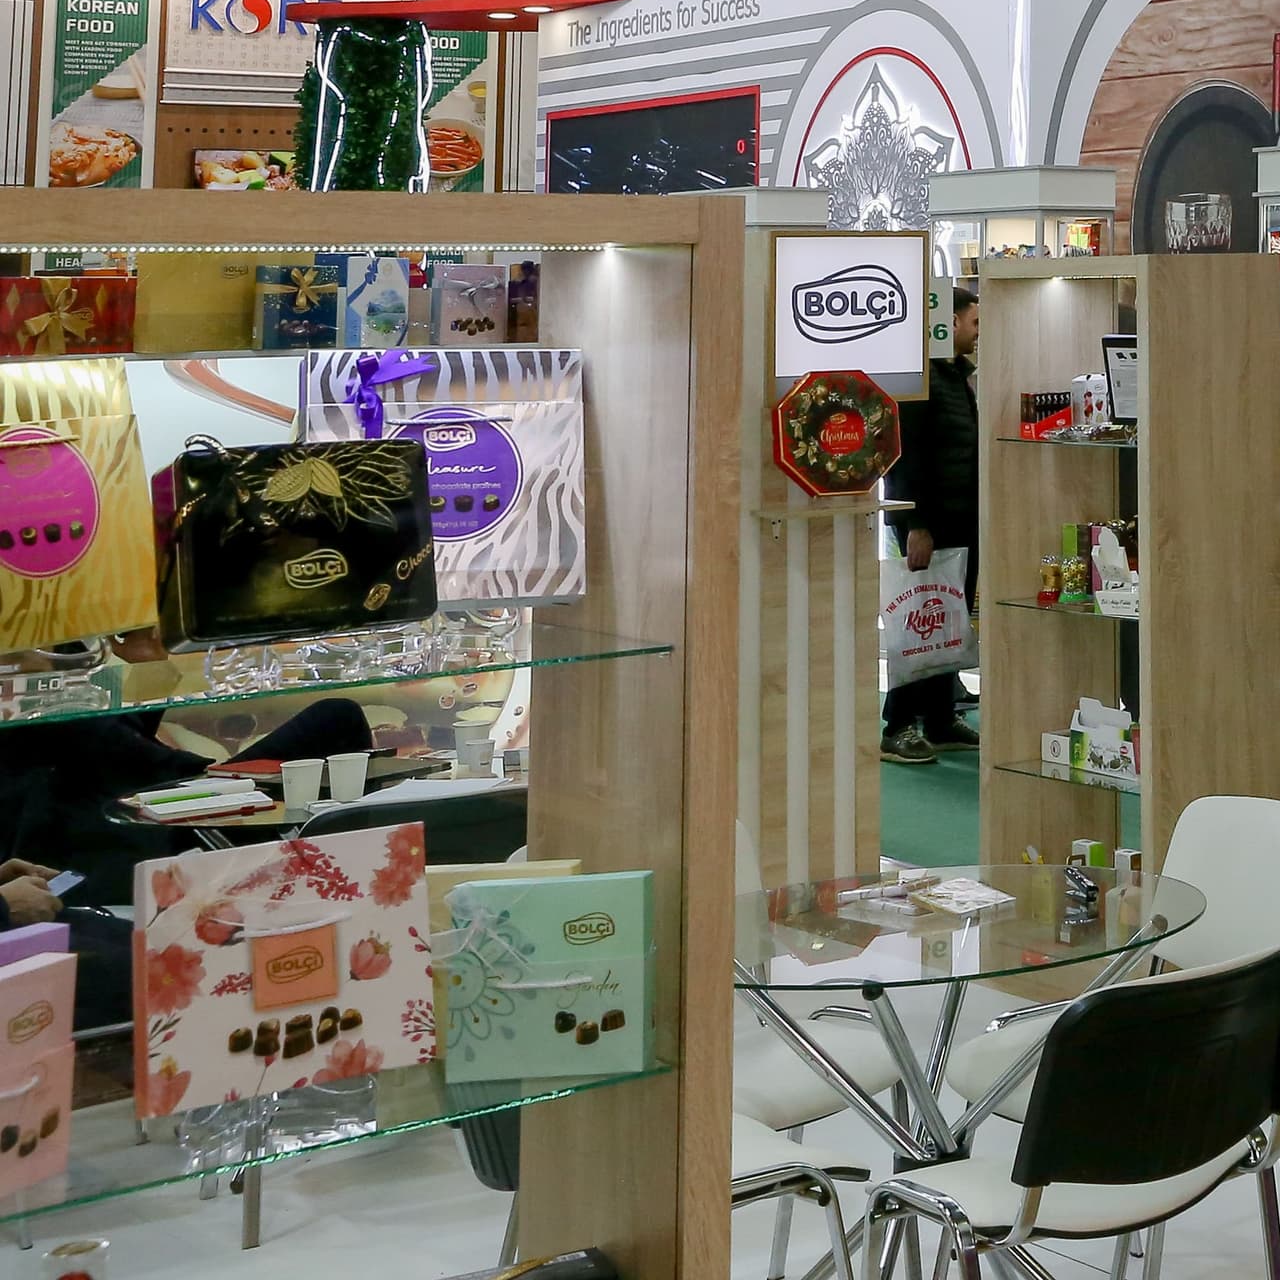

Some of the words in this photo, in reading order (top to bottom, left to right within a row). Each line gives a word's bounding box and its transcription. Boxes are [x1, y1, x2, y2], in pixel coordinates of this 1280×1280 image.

[66, 18, 115, 33] FOOD
[567, 21, 592, 47] The
[596, 6, 672, 48] Ingredients
[676, 1, 697, 30] for
[429, 36, 460, 50] OOD
[55, 258, 83, 268] HEA
[929, 323, 948, 340] 6
[427, 457, 497, 475] leasure
